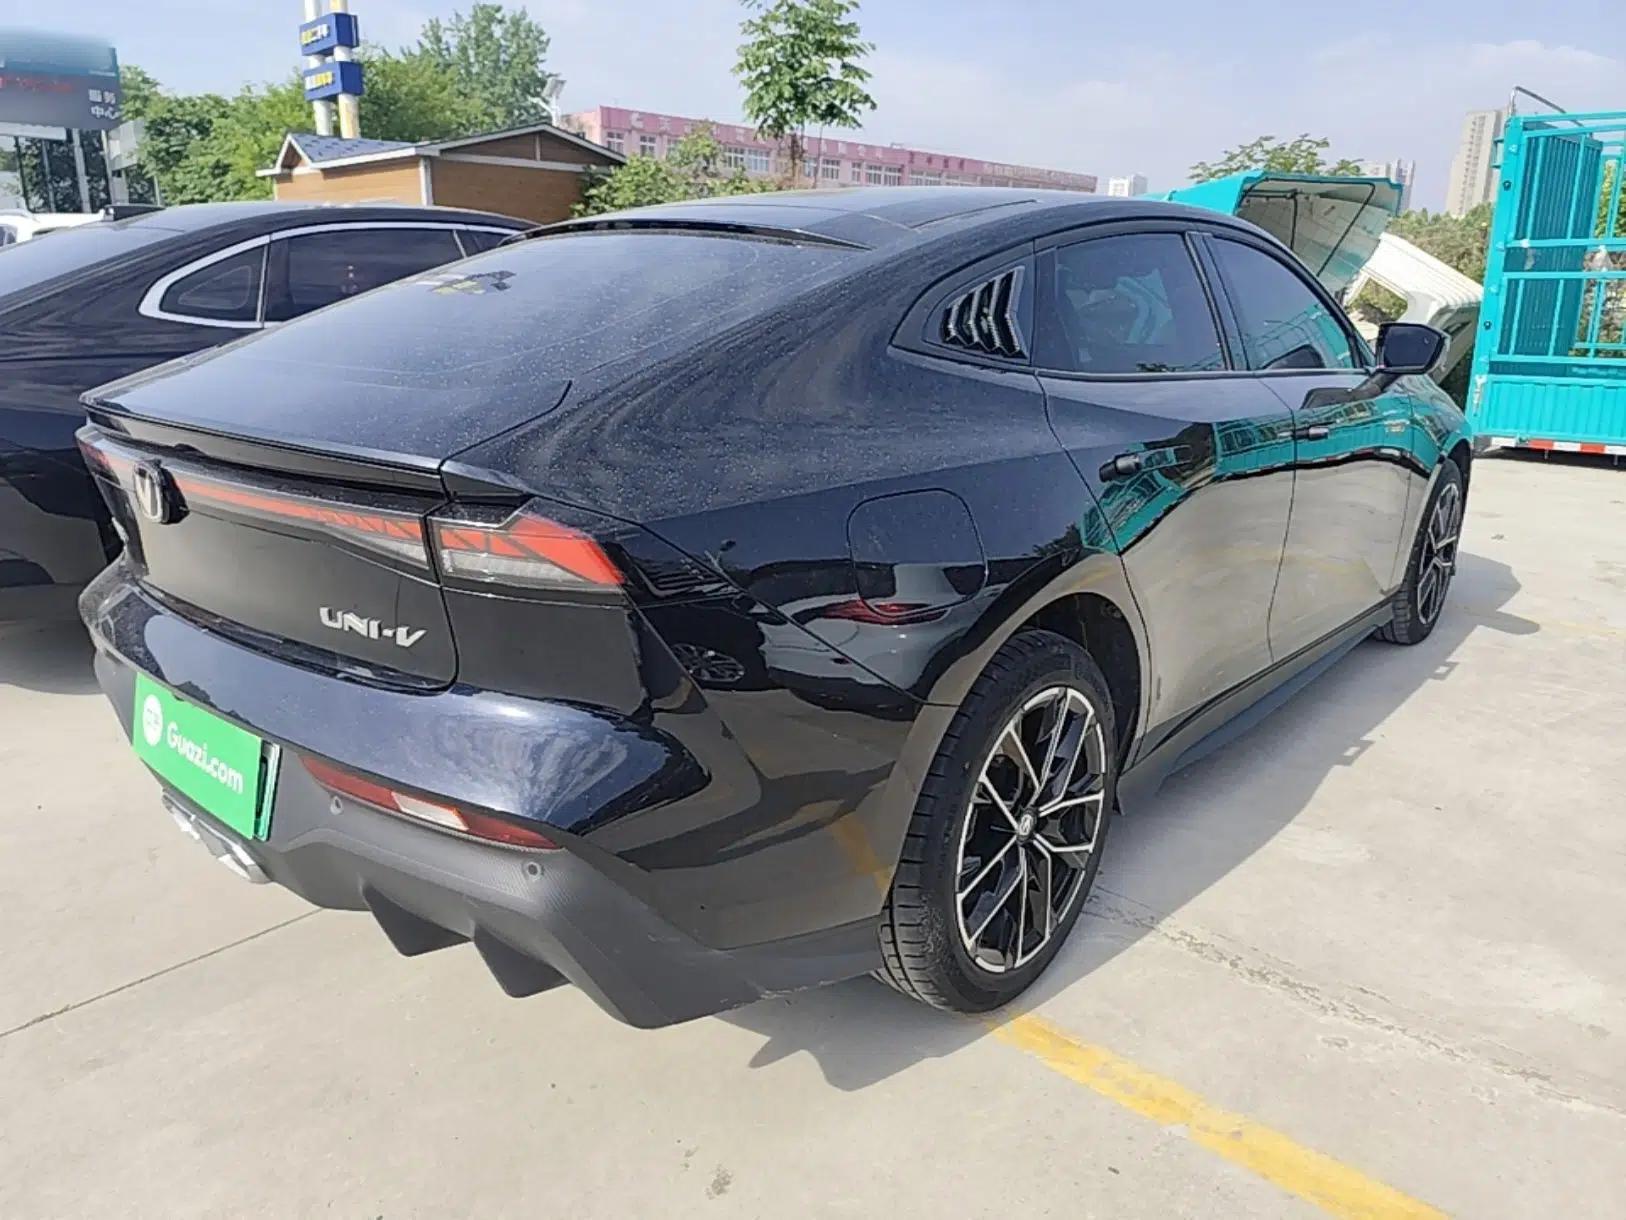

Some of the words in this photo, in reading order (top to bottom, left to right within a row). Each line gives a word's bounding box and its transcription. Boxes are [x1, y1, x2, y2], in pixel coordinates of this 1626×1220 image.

[90, 105, 120, 120] 中心
[319, 606, 427, 648] UNI-V
[166, 721, 244, 795] Guazi.com
